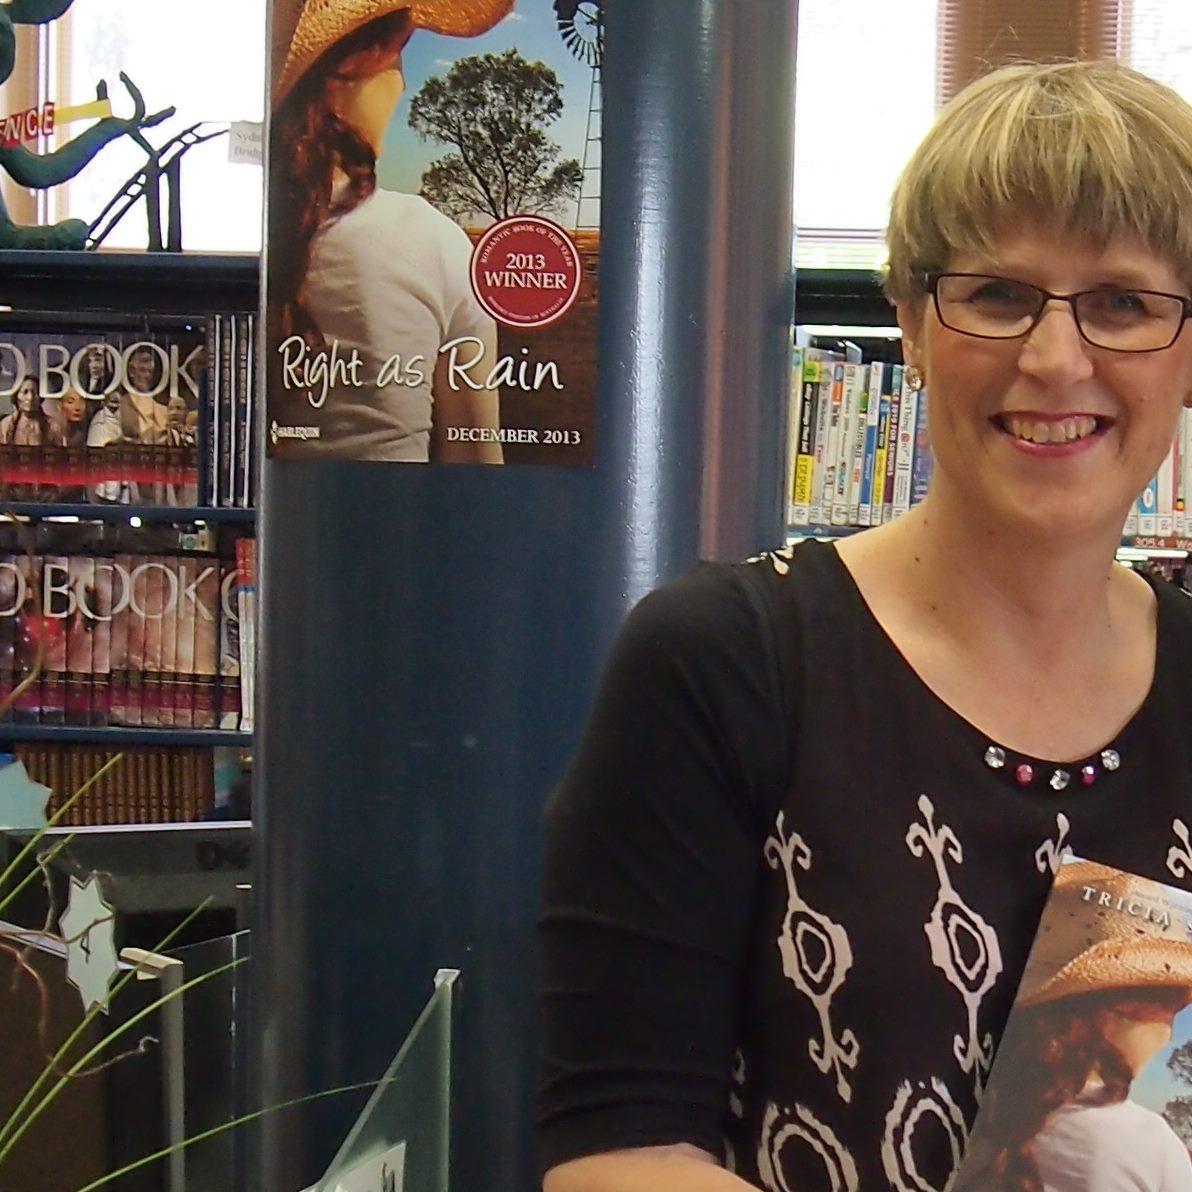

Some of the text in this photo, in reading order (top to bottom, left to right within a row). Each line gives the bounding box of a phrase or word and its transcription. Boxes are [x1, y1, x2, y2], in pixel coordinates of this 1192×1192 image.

[484, 271, 568, 290] WINNER
[505, 253, 546, 270] 2013
[39, 341, 204, 400] BOOK
[278, 335, 564, 408] Right as Rain
[447, 426, 582, 445] DECEMBER 2013
[43, 562, 215, 621] BOOK
[1082, 886, 1171, 928] TRICIA
